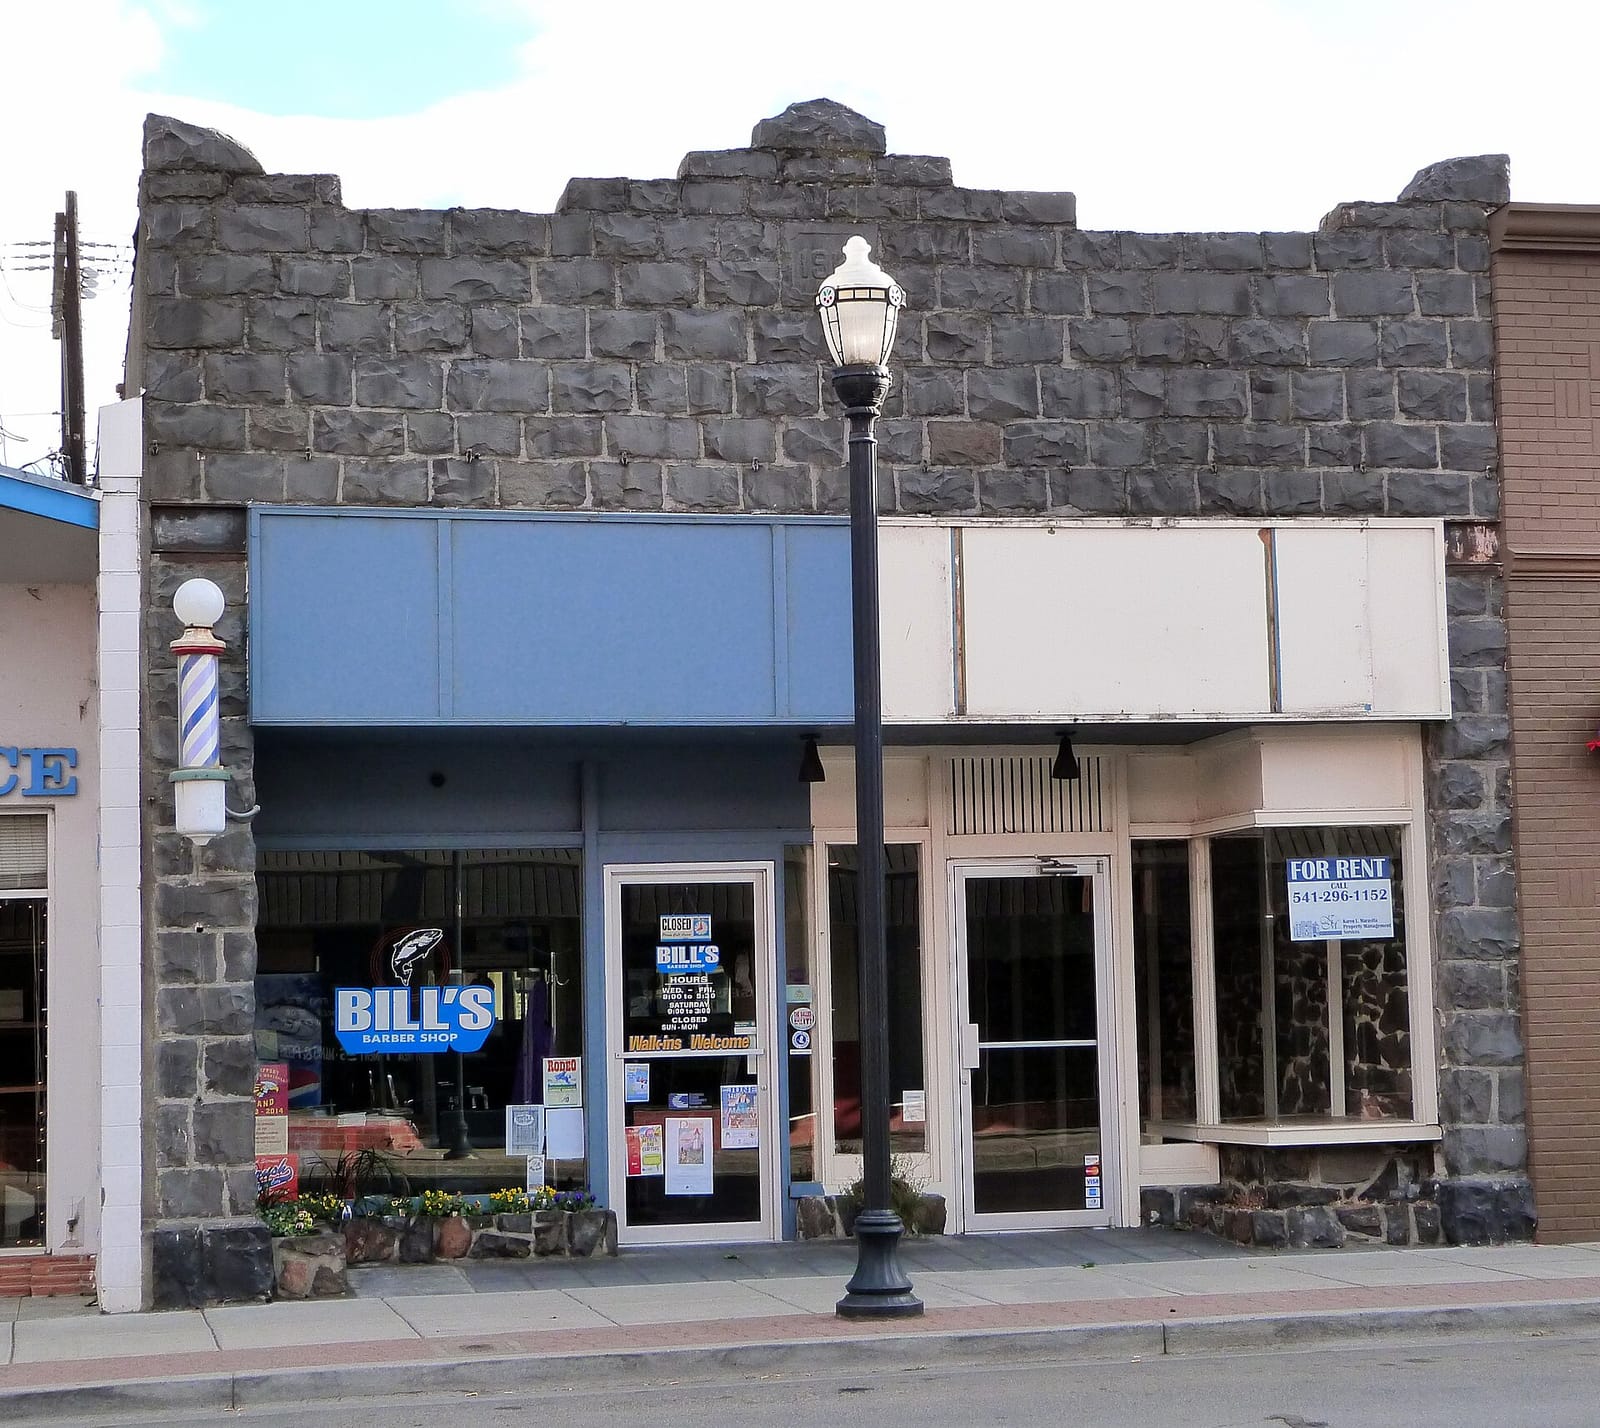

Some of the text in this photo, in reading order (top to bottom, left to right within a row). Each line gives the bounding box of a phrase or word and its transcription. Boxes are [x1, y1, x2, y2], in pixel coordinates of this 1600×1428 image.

[1290, 858, 1386, 880] FOR RENT
[1330, 882, 1348, 890] CALL
[1292, 889, 1388, 904] 541-296-1152
[662, 918, 692, 931] CLOSED
[656, 945, 720, 965] BILL'S
[670, 976, 708, 984] HOURS
[337, 988, 493, 1032] BILL'S
[669, 1001, 709, 1009] SATURDAY
[671, 1016, 708, 1024] CLOSED
[362, 1033, 458, 1043] BARBER SHOP
[629, 1034, 750, 1051] Walk-ins Welcome
[548, 1059, 577, 1072] RODEO
[265, 1107, 284, 1115] 2014
